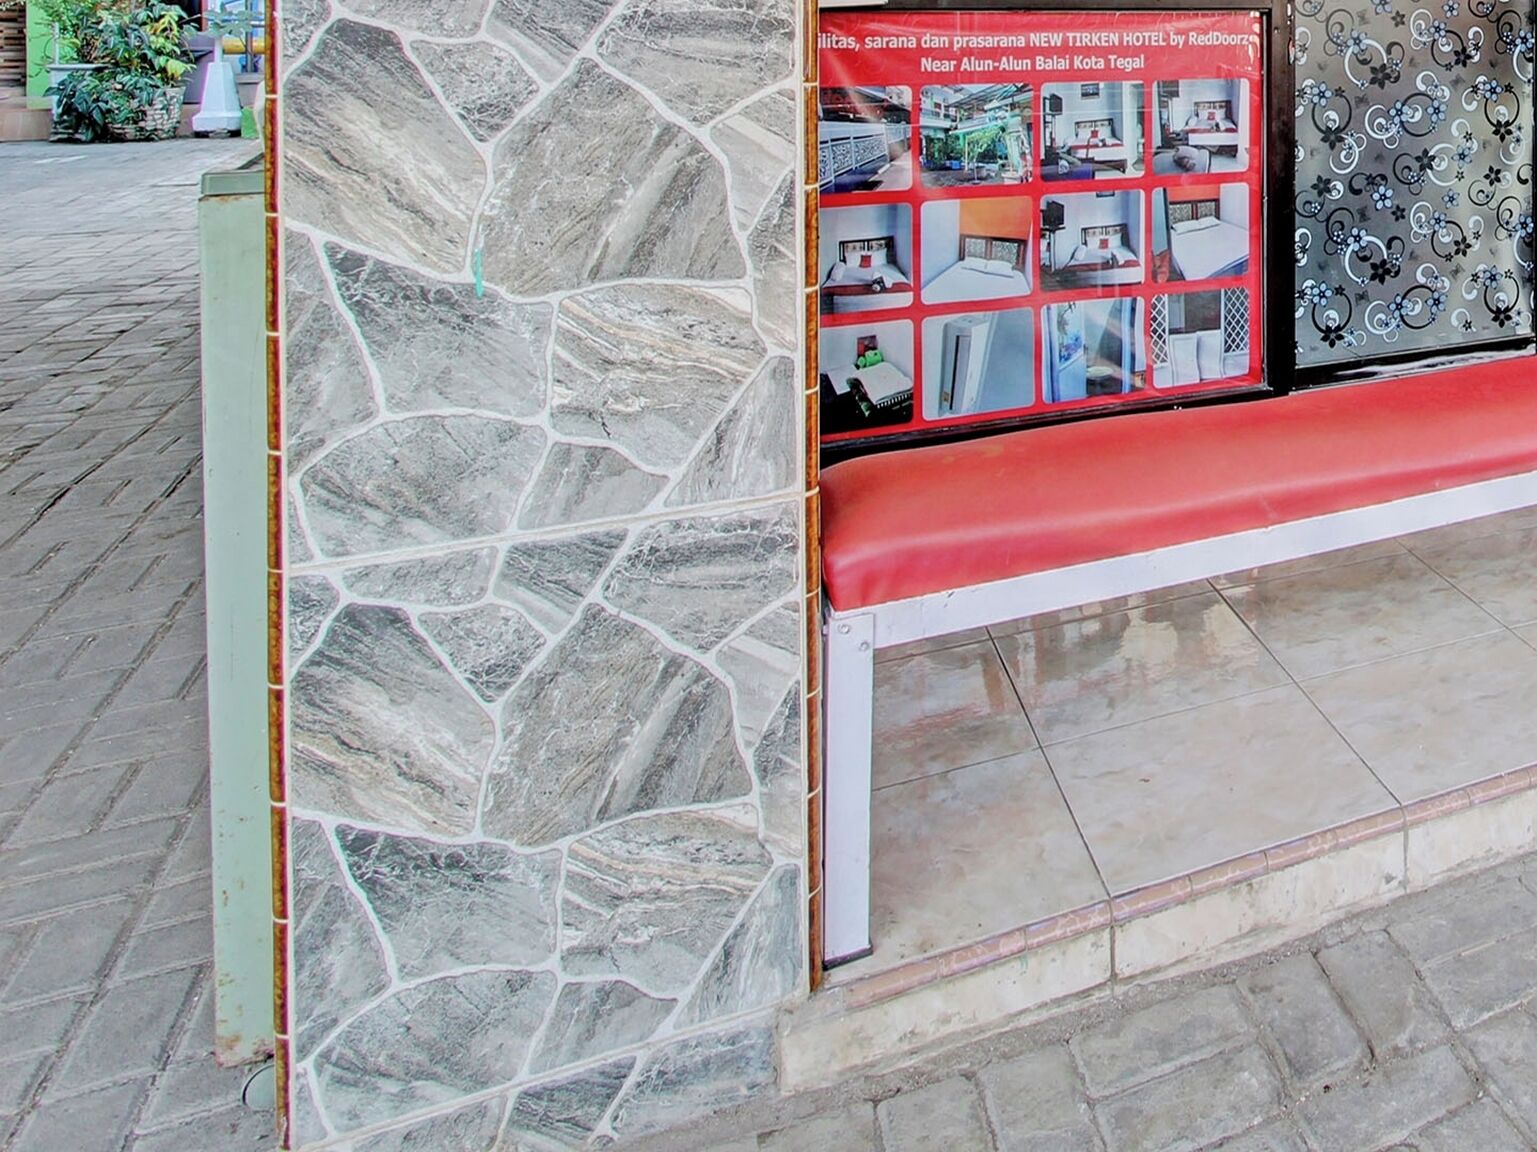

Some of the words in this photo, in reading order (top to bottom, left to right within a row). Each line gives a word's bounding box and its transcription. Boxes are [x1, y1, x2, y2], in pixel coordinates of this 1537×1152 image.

[818, 32, 860, 51] ilitas,
[864, 35, 916, 49] sarana
[921, 32, 949, 48] dan
[954, 33, 1025, 53] prasarana
[1030, 32, 1063, 47] NEW
[1067, 32, 1119, 46] TIRKEN
[1123, 32, 1166, 45] HOTEL
[1169, 32, 1185, 49] by
[1188, 31, 1249, 46] RedDoorz
[921, 57, 957, 72] Near
[960, 56, 1032, 72] Alun-Alun
[1035, 55, 1070, 71] Balai
[1073, 55, 1105, 70] Kota
[1108, 54, 1145, 74] Tegal
